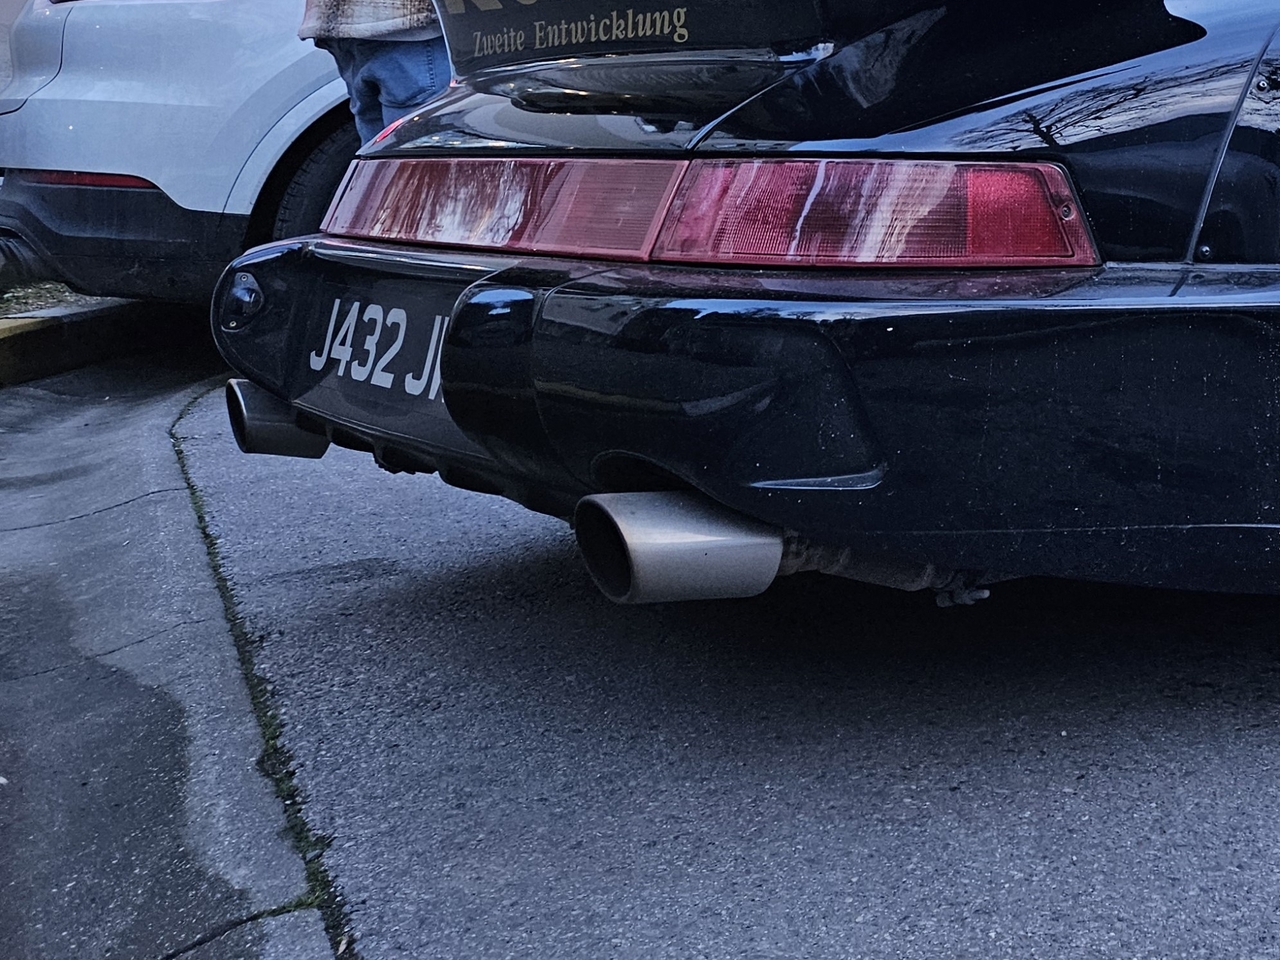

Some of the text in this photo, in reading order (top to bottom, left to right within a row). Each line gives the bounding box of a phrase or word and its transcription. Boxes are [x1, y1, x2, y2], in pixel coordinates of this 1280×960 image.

[473, 7, 690, 58] Zweite Entwicklung
[309, 298, 450, 403] J432 J
